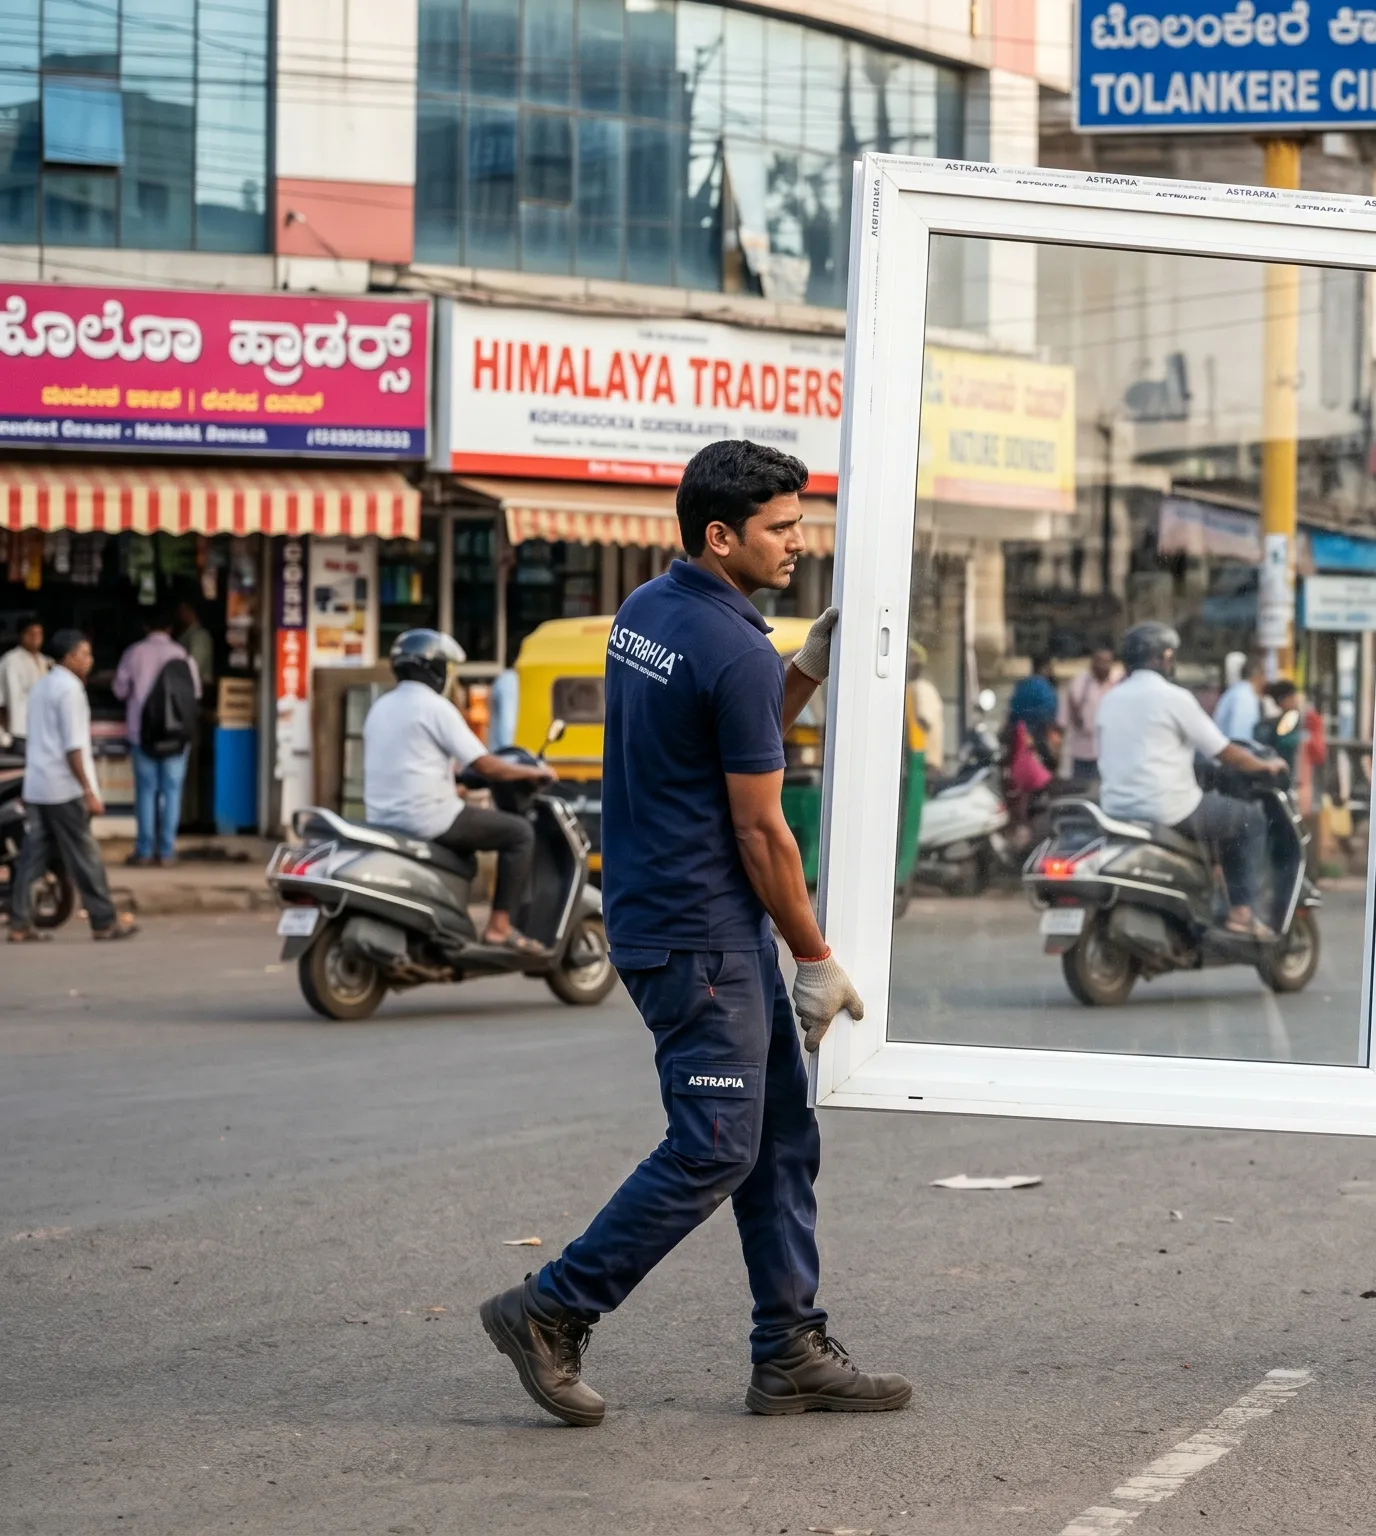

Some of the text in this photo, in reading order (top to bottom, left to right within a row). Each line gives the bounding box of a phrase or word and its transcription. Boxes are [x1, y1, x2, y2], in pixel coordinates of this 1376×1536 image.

[1091, 69, 1321, 116] TOLANKERE
[473, 337, 843, 421] HIMALAYA TRADERS
[688, 1075, 744, 1088] ASTRAPIA
